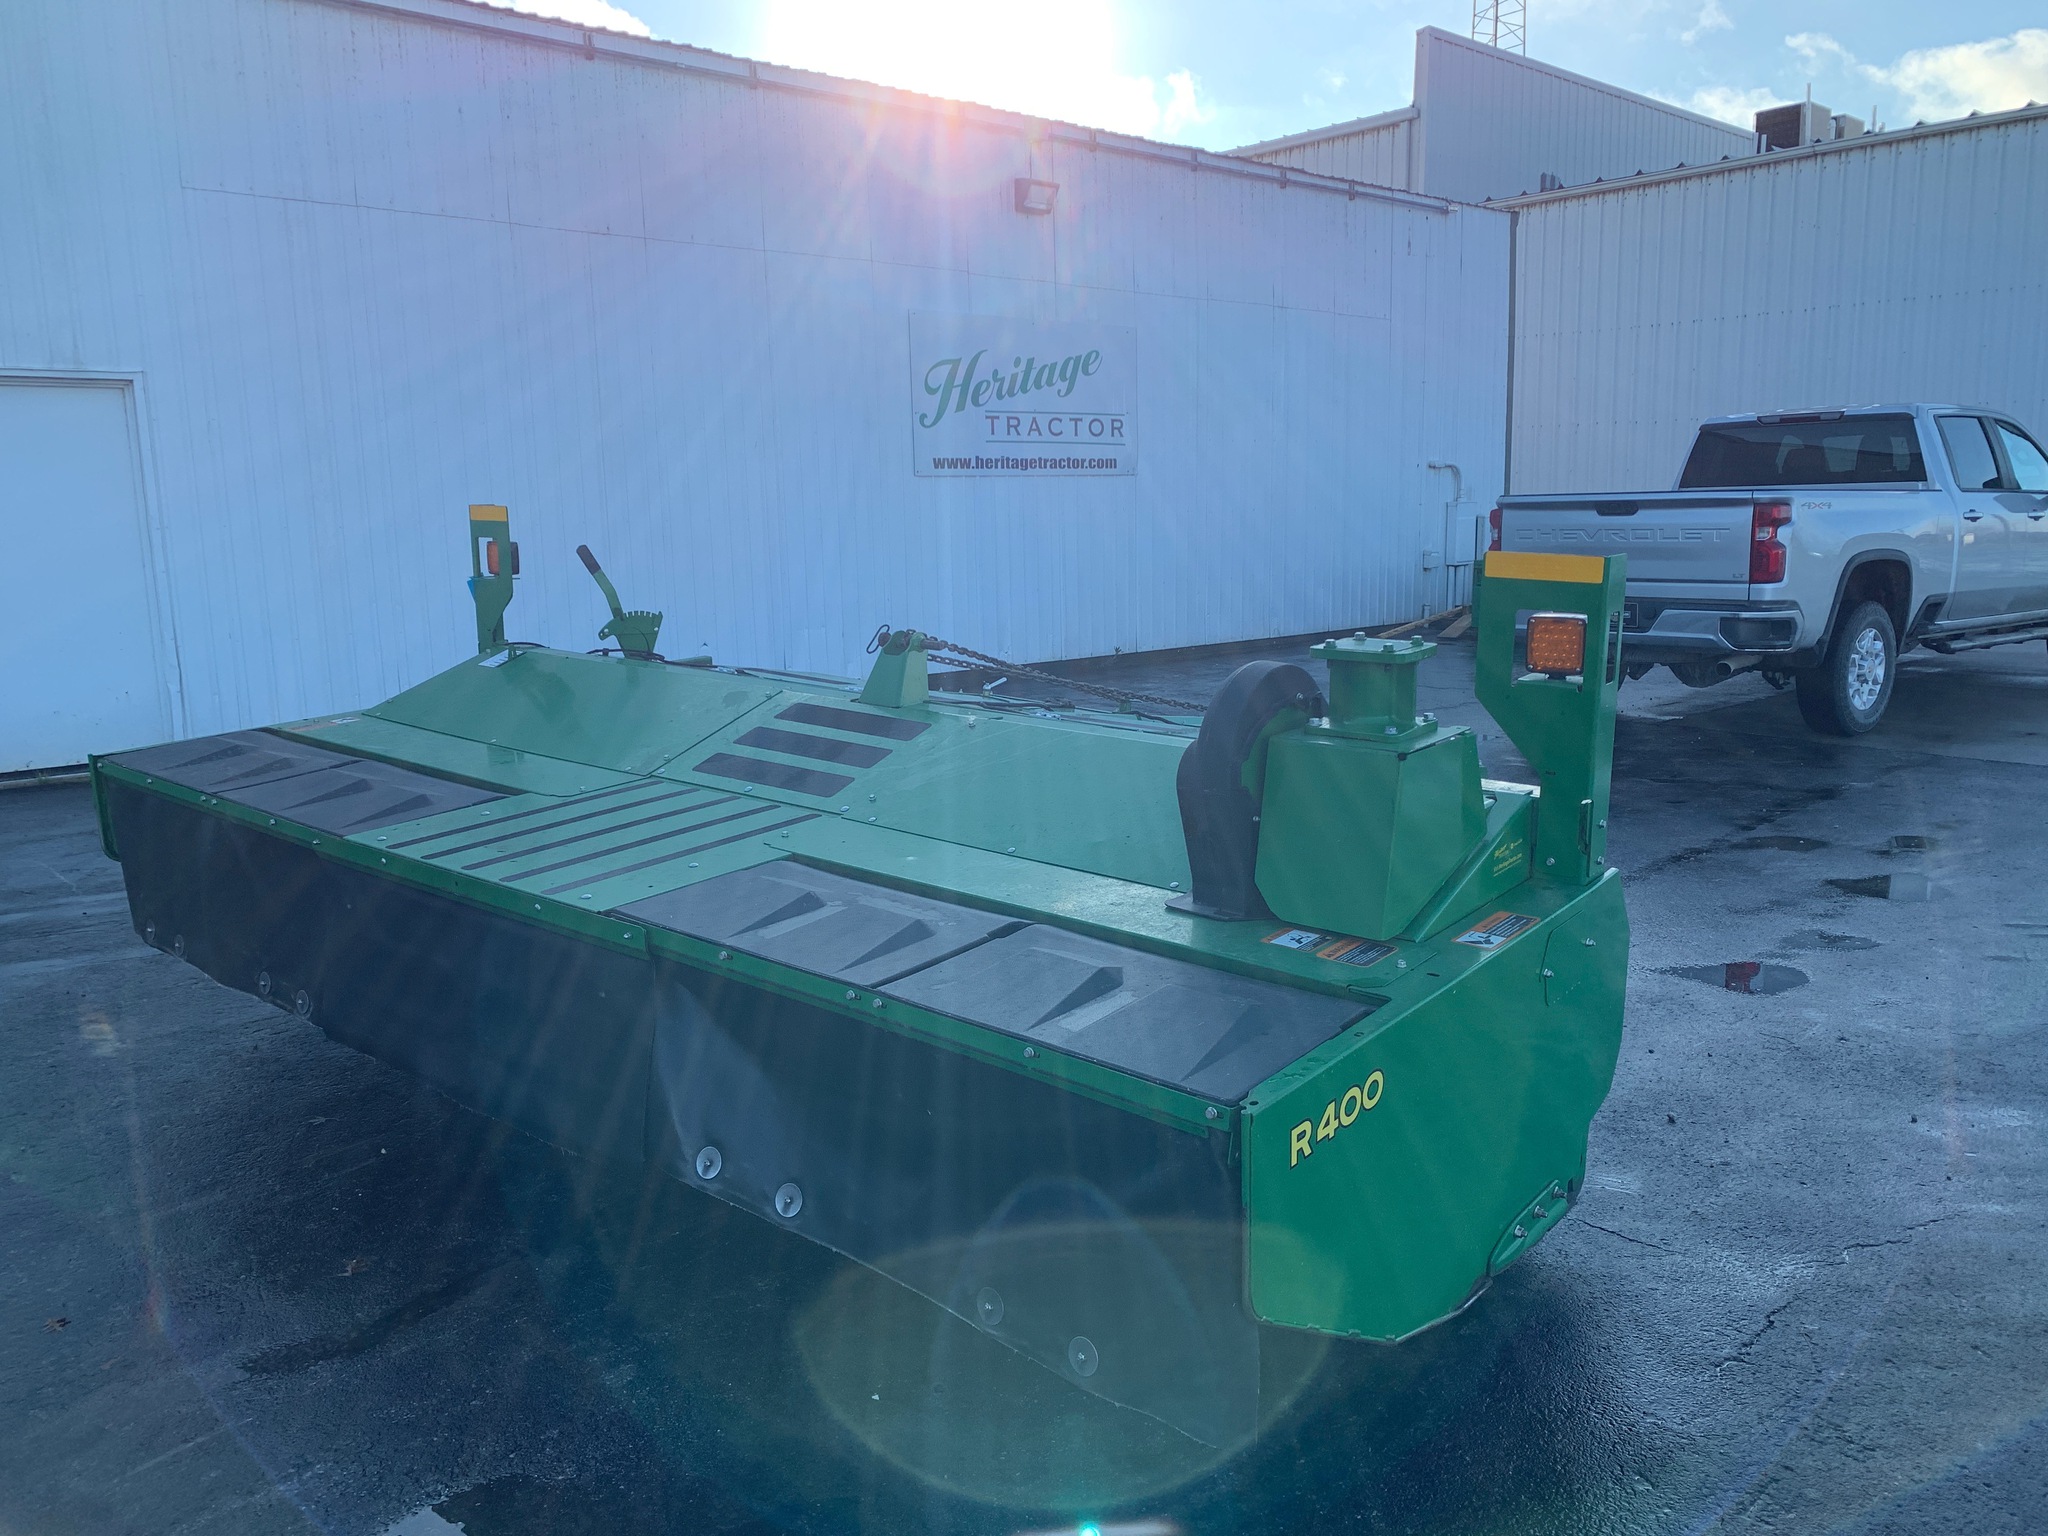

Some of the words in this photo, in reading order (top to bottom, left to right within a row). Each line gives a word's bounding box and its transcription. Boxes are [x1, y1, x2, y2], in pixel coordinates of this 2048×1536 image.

[919, 349, 1103, 428] Heritage
[985, 415, 1125, 438] TRACTOR
[932, 456, 1118, 471] www.heritagetractor.com
[1515, 528, 1731, 542] CHEVROLET
[1290, 1068, 1384, 1169] R400
